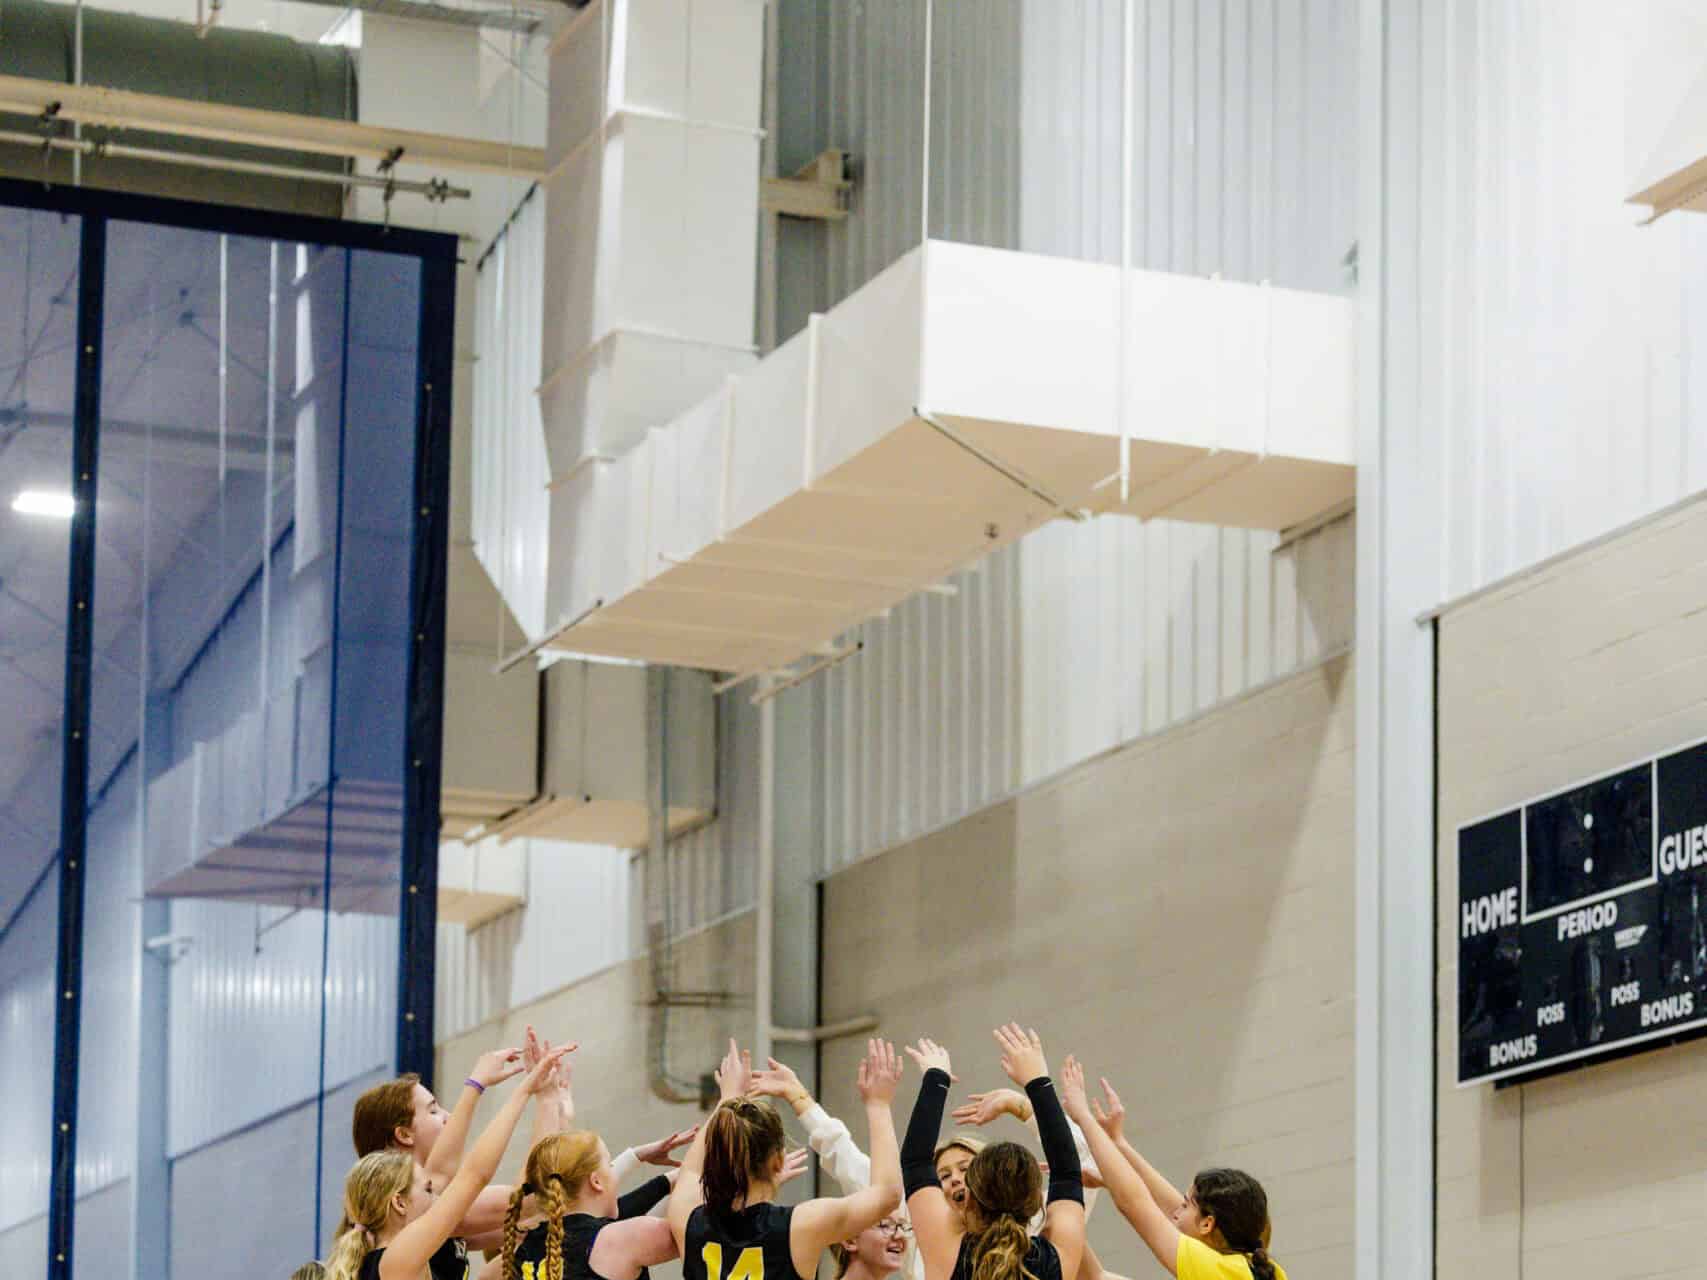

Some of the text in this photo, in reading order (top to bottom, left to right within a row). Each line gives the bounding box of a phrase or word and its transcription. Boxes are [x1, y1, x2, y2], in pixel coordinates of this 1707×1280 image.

[1462, 887, 1518, 938] HOME
[1558, 902, 1618, 941] PERIOD
[1611, 982, 1640, 1007] POSS
[1641, 992, 1694, 1027] BONUS
[1537, 1003, 1565, 1028] POSS
[1490, 1035, 1538, 1067] BONUS
